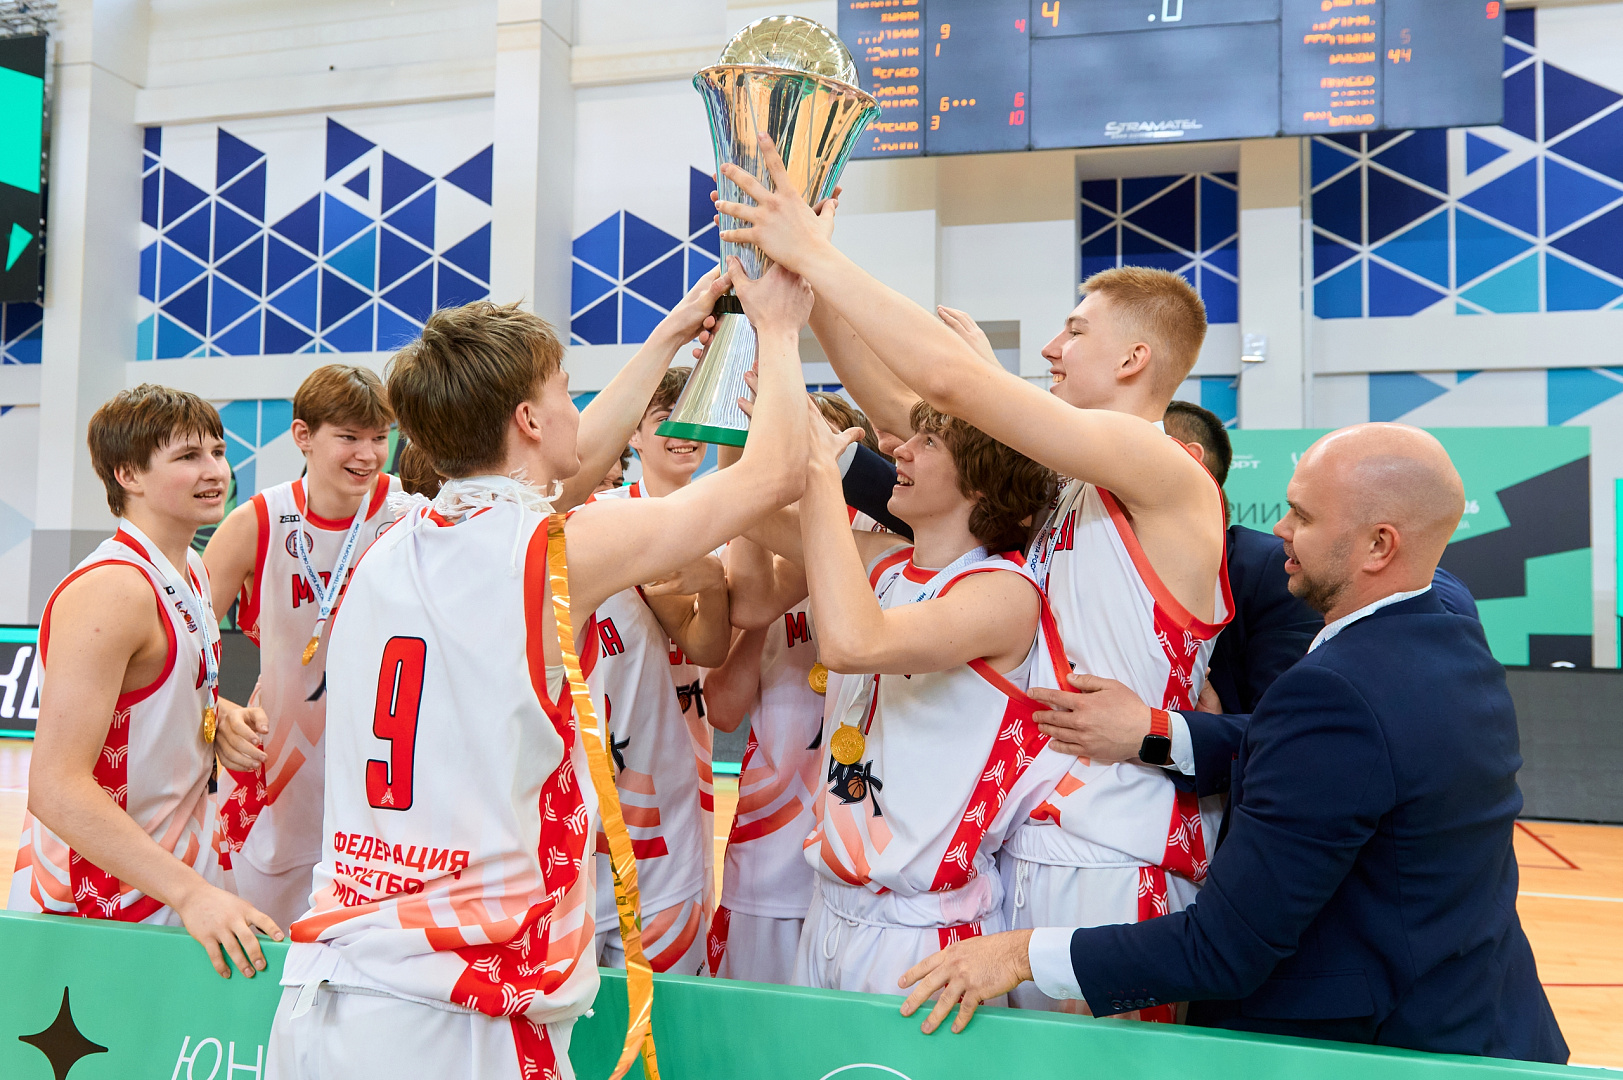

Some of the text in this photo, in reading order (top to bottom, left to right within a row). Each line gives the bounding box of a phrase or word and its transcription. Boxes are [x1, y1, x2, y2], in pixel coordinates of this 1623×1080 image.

[1041, 1, 1060, 27] 4
[1486, 1, 1500, 19] 9
[940, 23, 951, 39] 9
[1014, 19, 1026, 33] 4
[1387, 48, 1412, 64] 44
[1013, 92, 1025, 108] 6
[930, 115, 941, 130] 3
[1009, 110, 1025, 125] 10
[1104, 118, 1203, 135] STRAMATEL
[366, 635, 428, 811] 9
[333, 831, 470, 880] ФЕДЕРАЦИЯ
